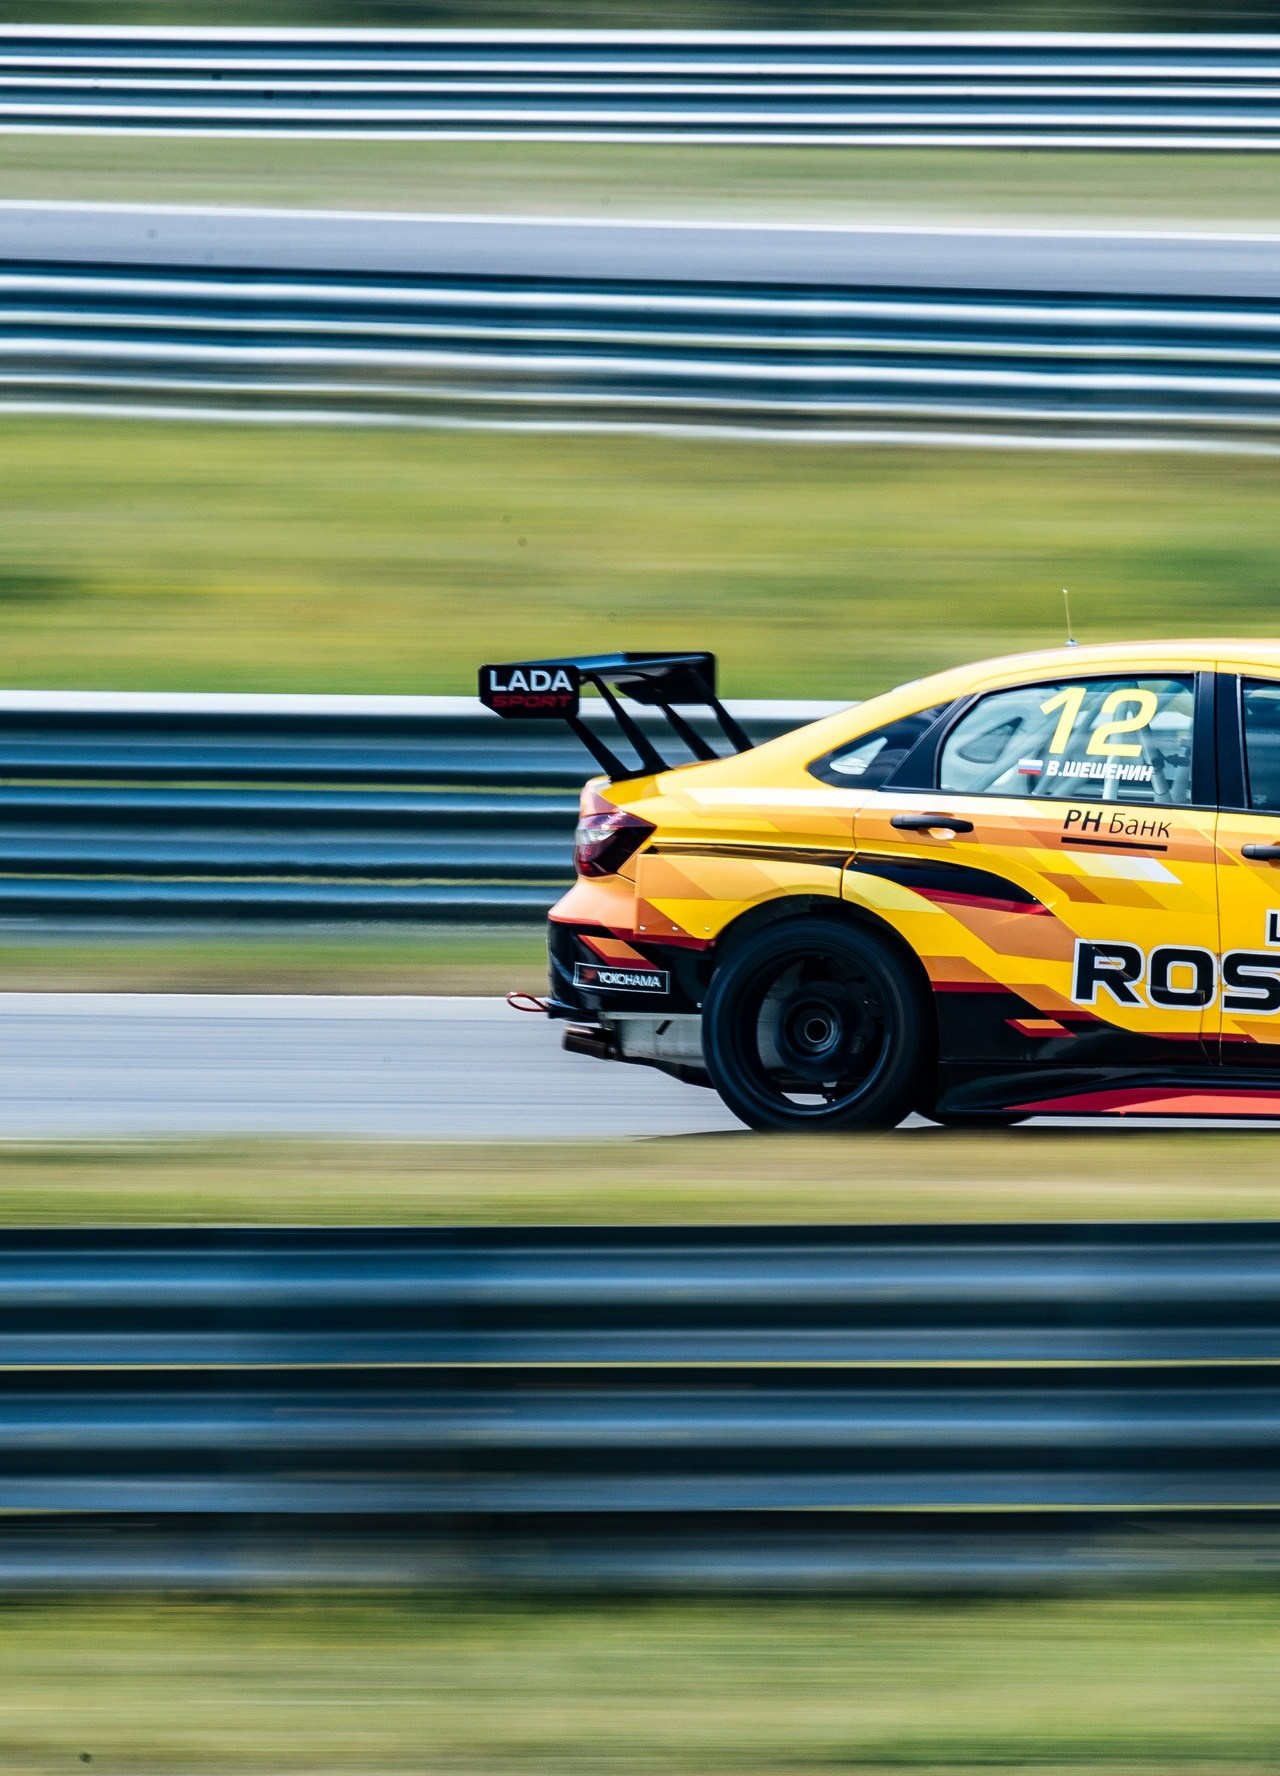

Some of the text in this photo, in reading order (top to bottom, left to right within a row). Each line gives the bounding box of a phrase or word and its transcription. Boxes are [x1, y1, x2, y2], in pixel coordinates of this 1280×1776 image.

[489, 670, 574, 692] LADA
[491, 695, 573, 708] SPORT
[1039, 687, 1159, 758] 12
[1046, 760, 1155, 782] В.ШЕШЕНИН
[1063, 809, 1173, 838] РН Банк
[597, 971, 662, 987] YOKOHAMA
